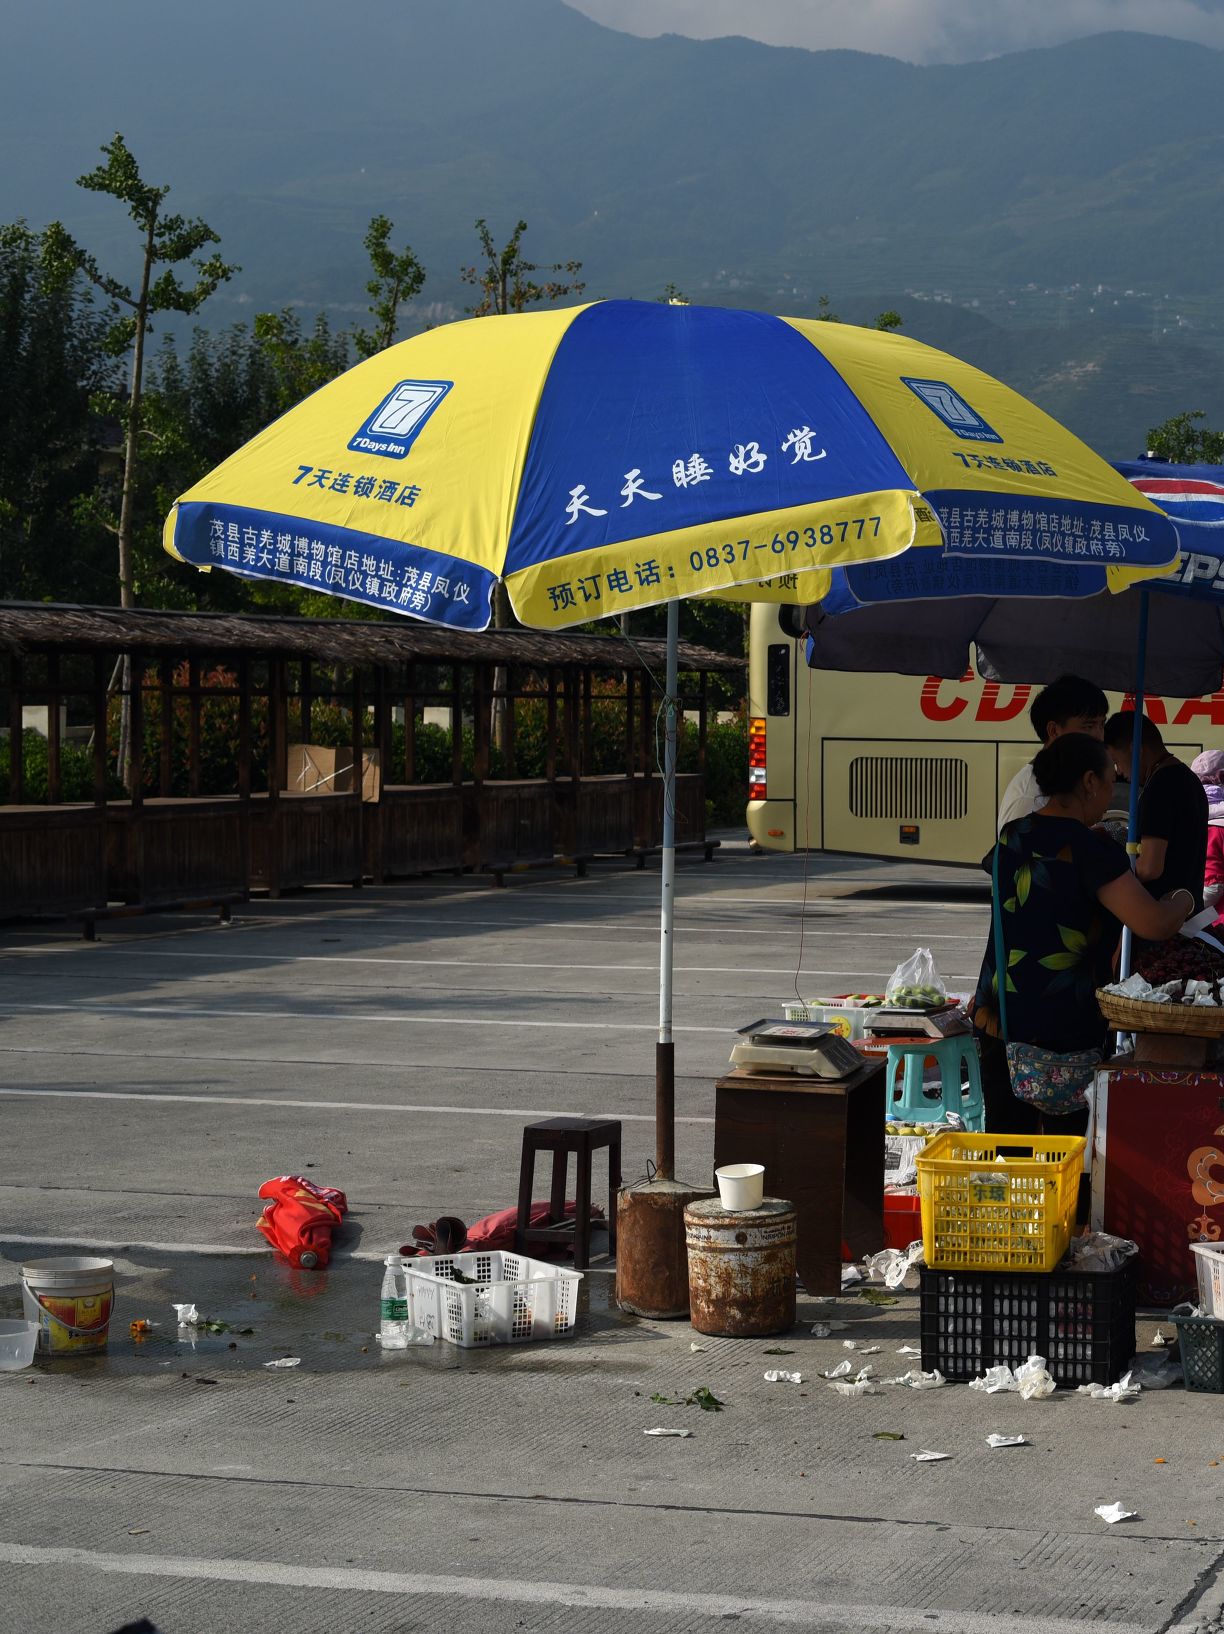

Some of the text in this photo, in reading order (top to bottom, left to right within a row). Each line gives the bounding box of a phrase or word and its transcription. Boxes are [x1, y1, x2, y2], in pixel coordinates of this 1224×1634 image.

[292, 464, 422, 508] 7天连锁酒店
[564, 425, 827, 526] 天天睡好觉
[952, 451, 1058, 477] 7天连锁酒店
